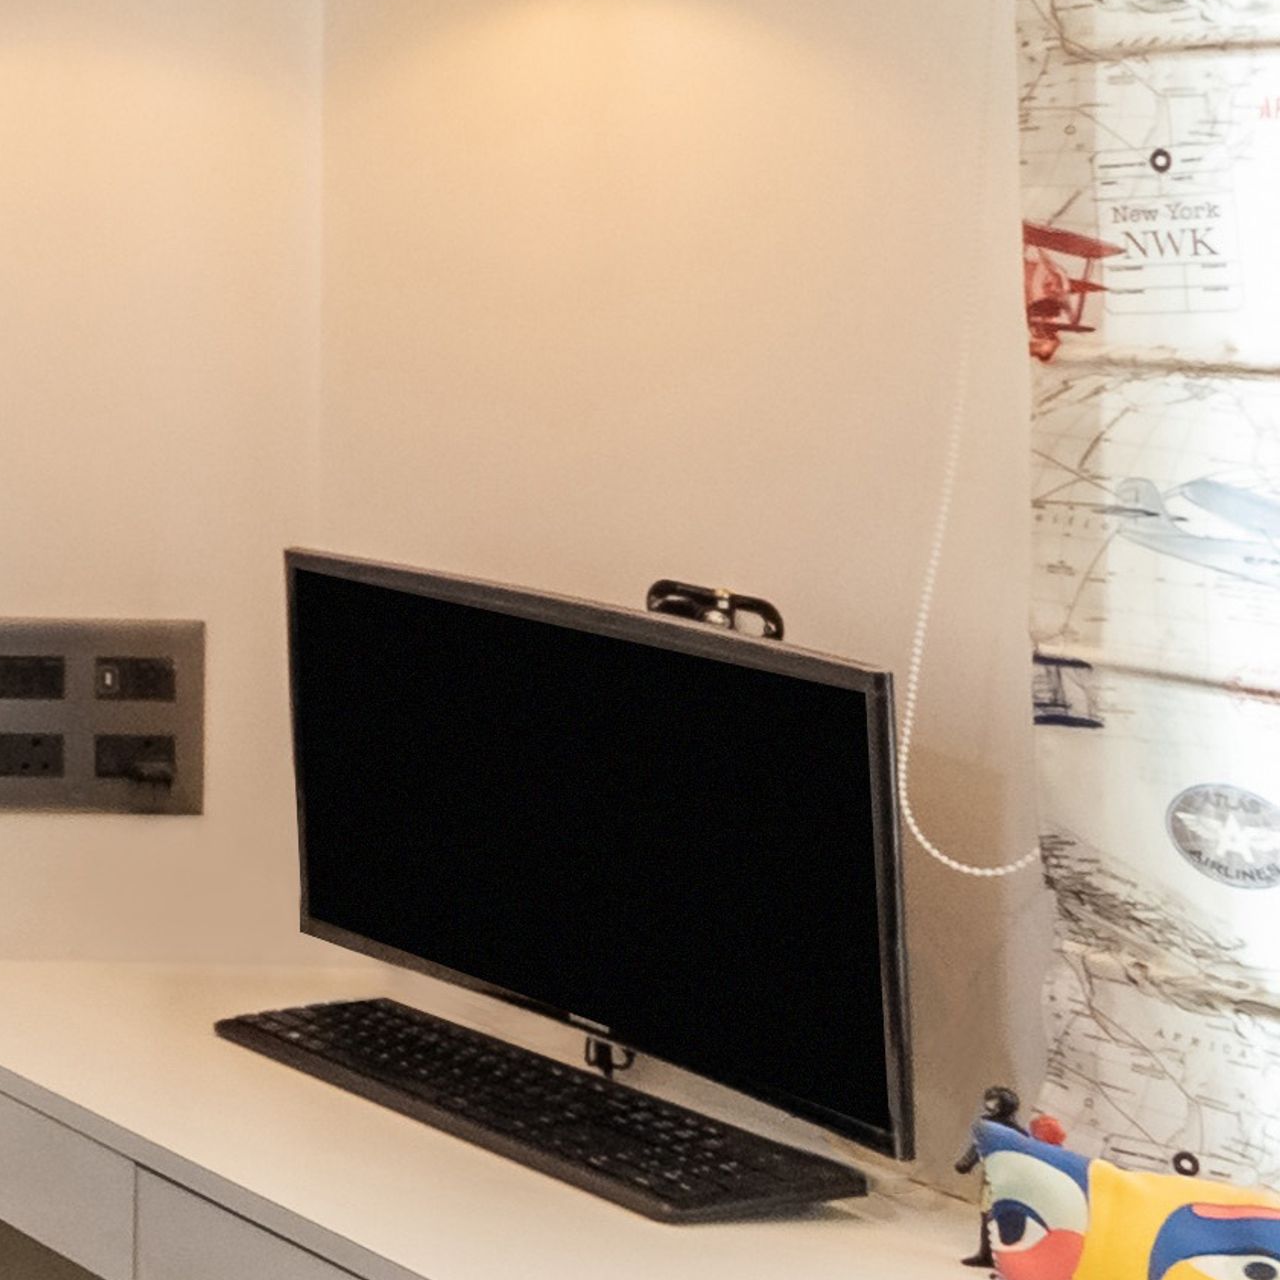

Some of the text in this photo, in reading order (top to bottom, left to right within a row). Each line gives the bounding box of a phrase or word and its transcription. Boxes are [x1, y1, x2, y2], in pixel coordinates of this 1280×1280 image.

[1111, 201, 1221, 224] New York
[1121, 227, 1221, 260] NWK
